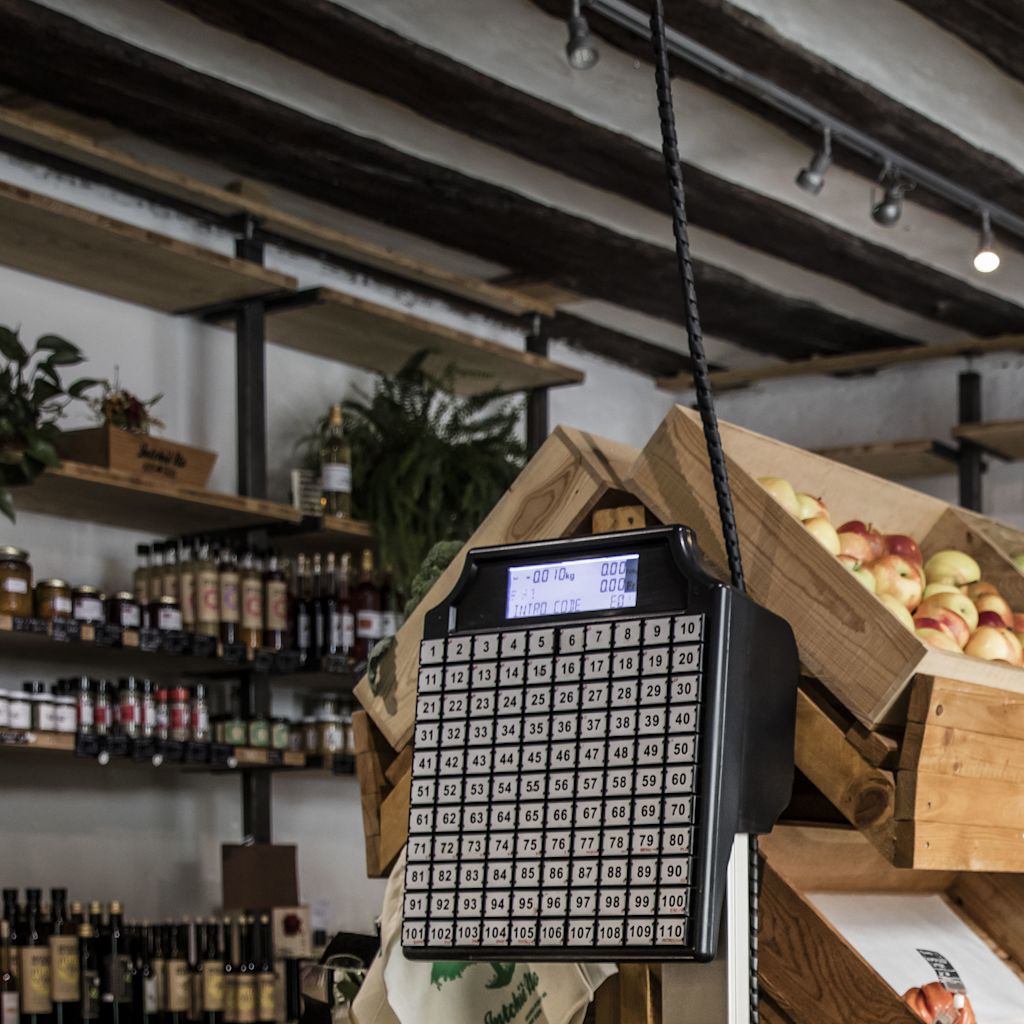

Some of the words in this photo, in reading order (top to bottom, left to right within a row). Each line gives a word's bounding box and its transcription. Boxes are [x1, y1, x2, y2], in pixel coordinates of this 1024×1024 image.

[430, 646, 436, 657] 1
[456, 643, 463, 655] 2
[483, 641, 489, 653] 3
[510, 638, 517, 650] 4
[538, 636, 545, 648] 5
[569, 634, 575, 646] 6
[596, 630, 602, 642] 7
[624, 628, 631, 640] 8
[654, 625, 661, 637] 9
[681, 622, 695, 635] 10
[425, 674, 436, 685] 11
[451, 671, 464, 683] 12
[478, 669, 491, 681] 13
[506, 667, 518, 679] 14
[533, 664, 547, 677] 15
[562, 662, 575, 675] 16
[590, 660, 604, 672] 17
[619, 657, 633, 670] 18
[649, 654, 662, 667] 19
[678, 652, 693, 665] 20
[423, 702, 435, 713] 21
[449, 700, 462, 712] 22
[476, 698, 489, 710] 23
[503, 696, 517, 708] 24
[531, 693, 545, 706] 25
[559, 691, 573, 704] 26
[588, 689, 603, 702] 27
[617, 687, 632, 700] 28
[646, 684, 661, 697] 29
[677, 682, 691, 695] 30
[421, 730, 433, 741] 31
[447, 728, 460, 740] 32
[474, 726, 487, 738] 33
[502, 724, 515, 736] 34
[529, 722, 543, 735] 35
[558, 720, 571, 733] 36
[587, 719, 601, 731] 37
[616, 716, 630, 729] 38
[645, 714, 660, 727] 39
[675, 712, 690, 725] 40
[419, 758, 431, 769] 41
[445, 756, 458, 768] 42
[472, 755, 486, 766] 43
[500, 753, 513, 765] 44
[528, 751, 542, 763] 45
[556, 749, 570, 761] 46
[585, 748, 599, 760] 47
[614, 746, 628, 759] 48
[643, 744, 658, 757] 49
[674, 742, 688, 755] 50
[417, 786, 429, 797] 51
[443, 784, 456, 796] 52
[471, 783, 484, 795] 53
[498, 782, 511, 794] 54
[526, 780, 540, 792] 55
[555, 779, 568, 791] 56
[583, 778, 597, 790] 57
[612, 776, 626, 788] 58
[642, 774, 656, 787] 59
[672, 773, 686, 785] 60
[416, 814, 428, 825] 61
[443, 813, 456, 824] 62
[470, 812, 483, 824] 63
[497, 811, 511, 823] 64
[525, 810, 539, 822] 65
[553, 809, 567, 821] 66
[583, 807, 597, 819] 67
[611, 806, 626, 818] 68
[641, 805, 656, 817] 69
[671, 803, 685, 816] 70
[414, 843, 426, 854] 71
[441, 842, 454, 854] 72
[468, 840, 481, 852] 73
[496, 840, 509, 851] 74
[523, 839, 537, 851] 75
[552, 838, 565, 850] 76
[581, 837, 594, 849] 77
[610, 836, 623, 848] 78
[639, 834, 654, 846] 79
[669, 834, 684, 846] 80
[412, 871, 424, 882] 81
[438, 870, 452, 882] 82
[465, 870, 479, 881] 83
[493, 869, 506, 881] 84
[521, 867, 535, 879] 85
[549, 867, 563, 879] 86
[578, 867, 593, 879] 87
[607, 866, 622, 878] 88
[637, 865, 651, 878] 89
[667, 865, 682, 877] 90
[410, 899, 421, 910] 91
[436, 899, 450, 910] 92
[464, 898, 477, 910] 93
[491, 898, 504, 910] 94
[519, 897, 533, 909] 95
[547, 897, 561, 909] 96
[576, 896, 590, 908] 97
[605, 896, 620, 908] 98
[635, 895, 649, 908] 99
[662, 895, 683, 907] 100
[406, 928, 423, 940] 101
[431, 928, 451, 940] 102
[459, 926, 478, 938] 103
[486, 927, 506, 938] 104
[514, 927, 534, 939] 105
[543, 927, 562, 939] 106
[571, 927, 592, 939] 107
[600, 927, 620, 939] 108
[630, 925, 651, 938] 109
[660, 925, 682, 937] 110
